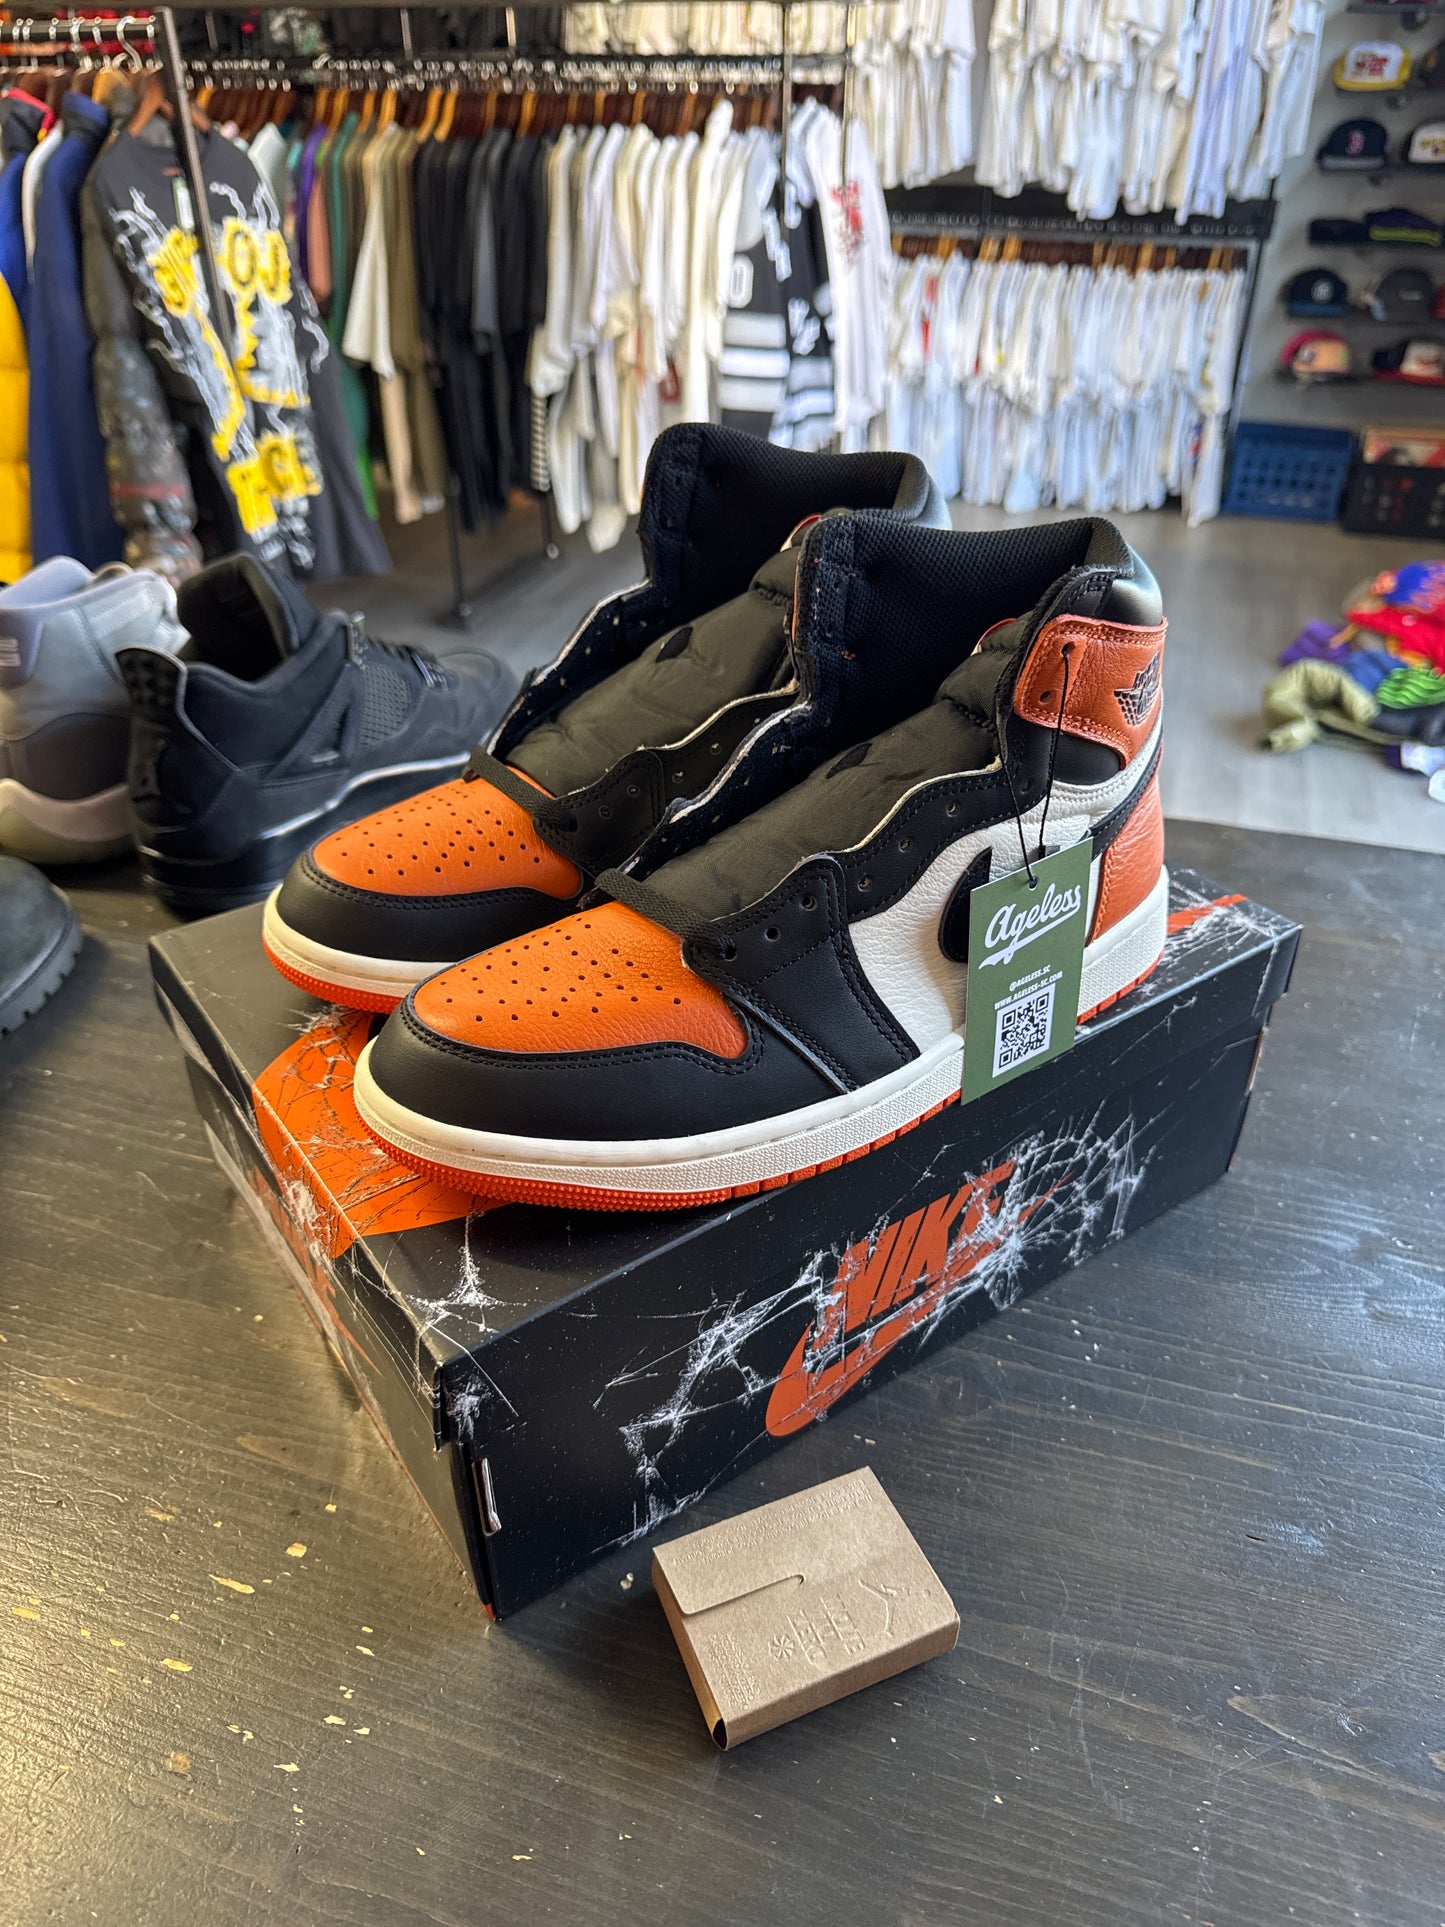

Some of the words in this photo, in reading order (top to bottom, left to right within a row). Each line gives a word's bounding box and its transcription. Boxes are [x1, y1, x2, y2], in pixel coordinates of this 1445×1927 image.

[979, 882, 1082, 968] Ageless
[994, 971, 1063, 1010] WWW.AGELESS-SC.COM
[1009, 964, 1051, 991] @AGELESS.SC
[812, 1160, 1016, 1351] NIKE
